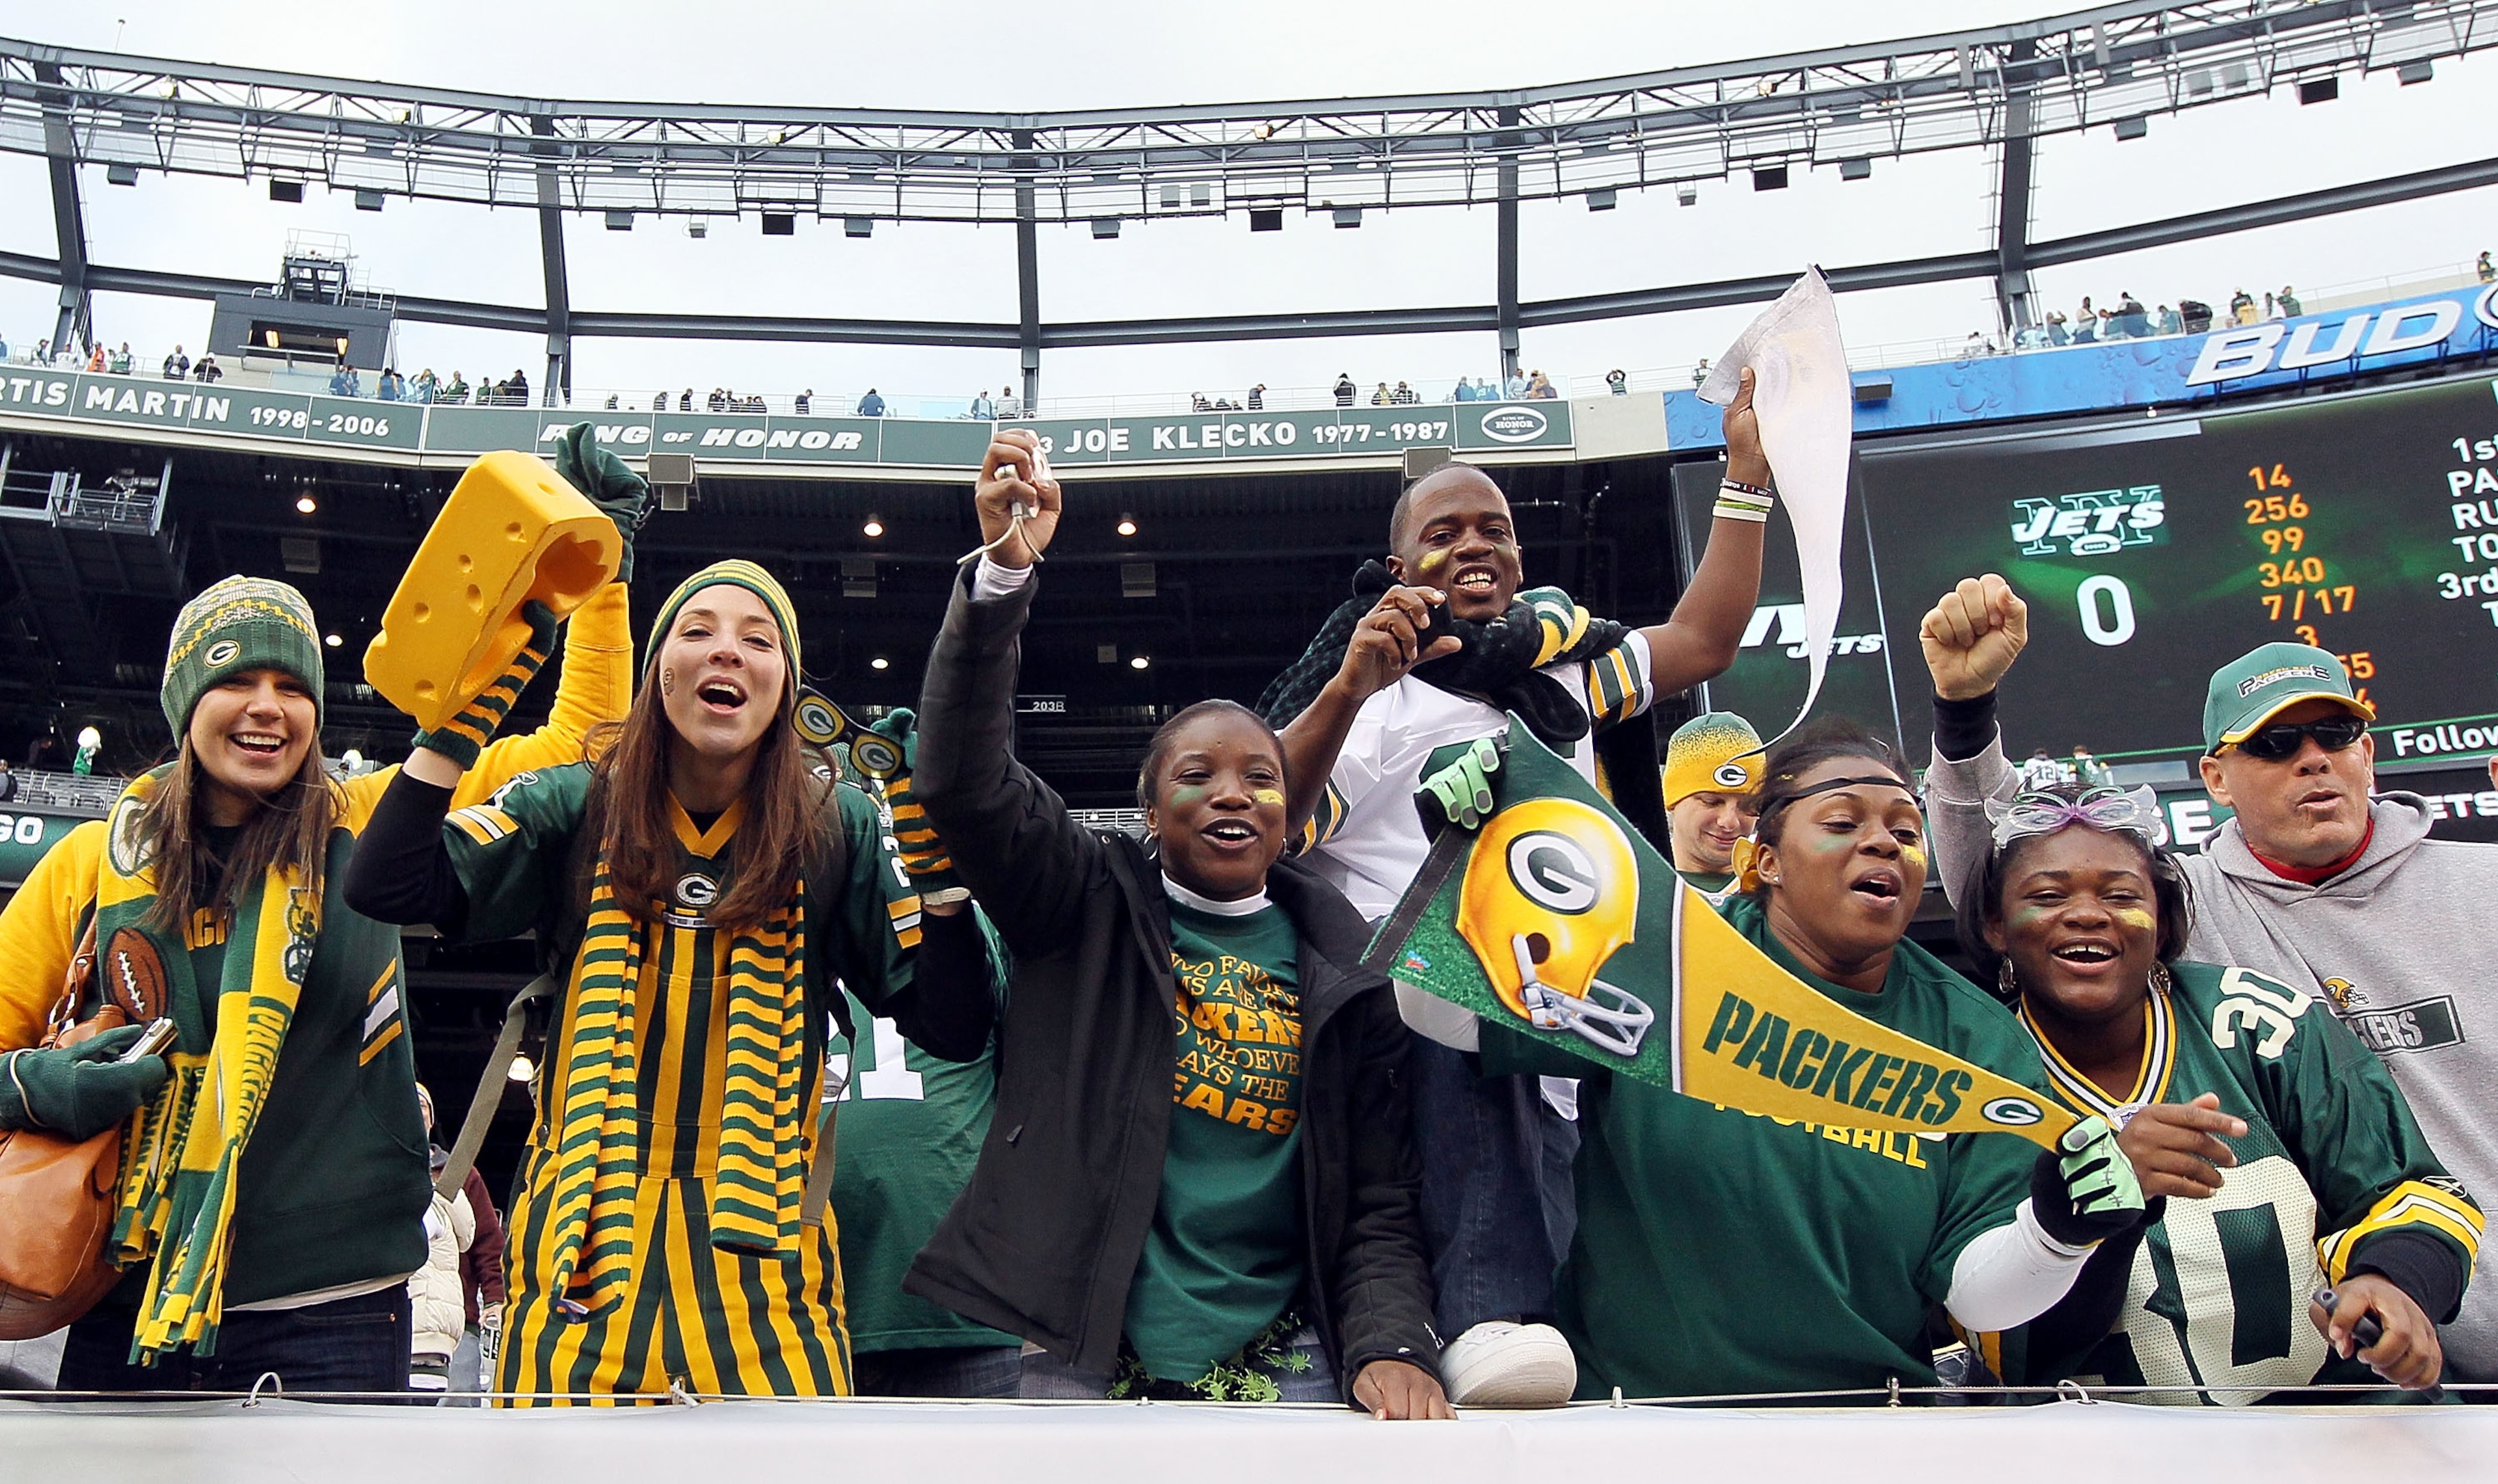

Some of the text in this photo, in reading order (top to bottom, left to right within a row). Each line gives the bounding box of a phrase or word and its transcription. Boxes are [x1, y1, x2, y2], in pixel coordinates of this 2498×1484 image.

[2186, 300, 2463, 386] BUD
[0, 377, 68, 406] TIS
[85, 386, 230, 422] MARTIN
[539, 424, 863, 451] RNG OF HONOR
[1064, 428, 1130, 453] JOE
[1153, 421, 1296, 450] KLECKO
[1495, 420, 1534, 429] HONOR
[2248, 463, 2293, 491] 14
[2011, 501, 2165, 543] JETS
[2244, 493, 2311, 525] 256
[2261, 526, 2305, 555] 99
[2259, 556, 2326, 588] 340
[2076, 575, 2136, 646] 0
[2236, 664, 2331, 698] PACKERS
[1033, 701, 1064, 711] 203B
[1196, 1029, 1300, 1075] WHOEVE
[1702, 990, 1973, 1126] PACKERS
[1241, 1074, 1289, 1101] THE
